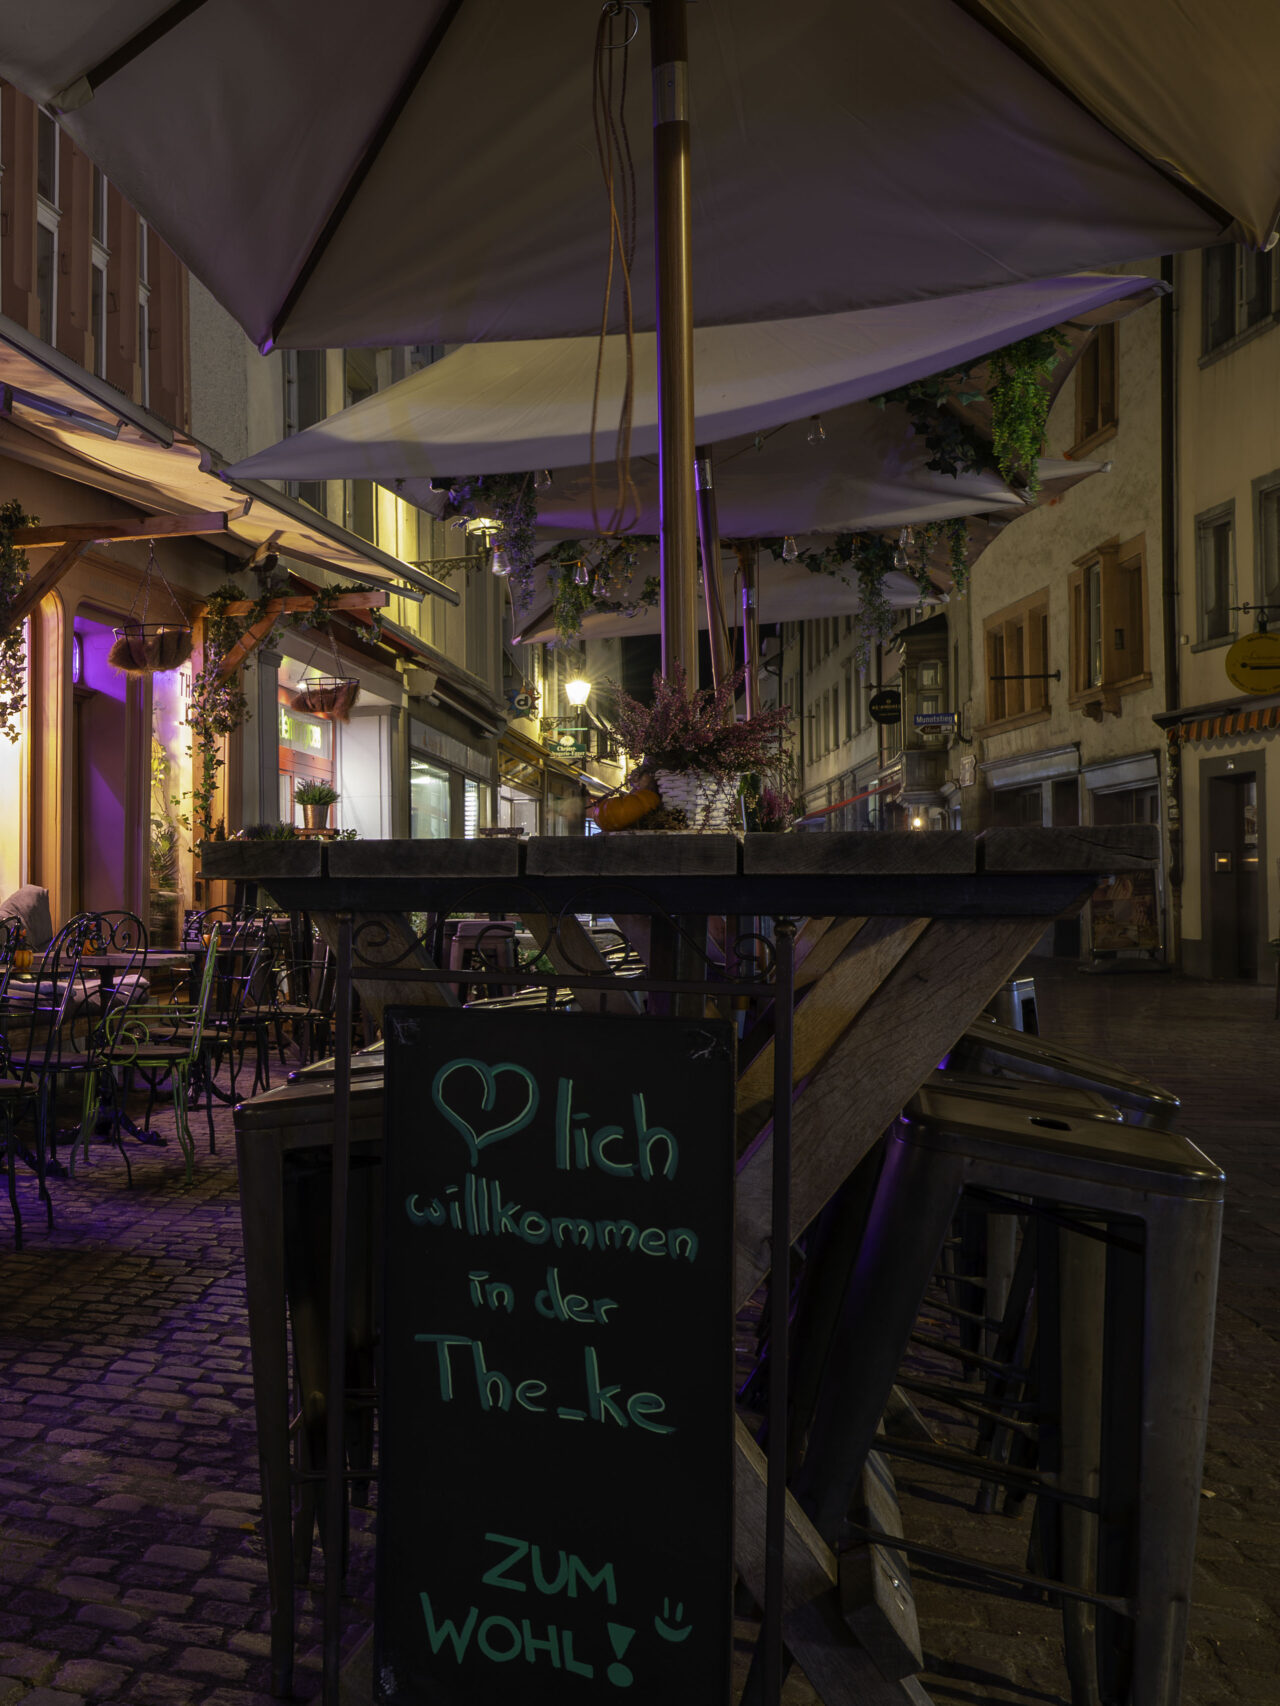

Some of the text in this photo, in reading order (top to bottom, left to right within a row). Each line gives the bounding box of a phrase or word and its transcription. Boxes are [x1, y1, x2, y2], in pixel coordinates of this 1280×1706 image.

[555, 1076, 680, 1183] lich
[405, 1173, 700, 1264] willkommen
[467, 1266, 620, 1325] in der
[480, 1532, 619, 1606] ZUM
[419, 1591, 637, 1689] WOHL!
